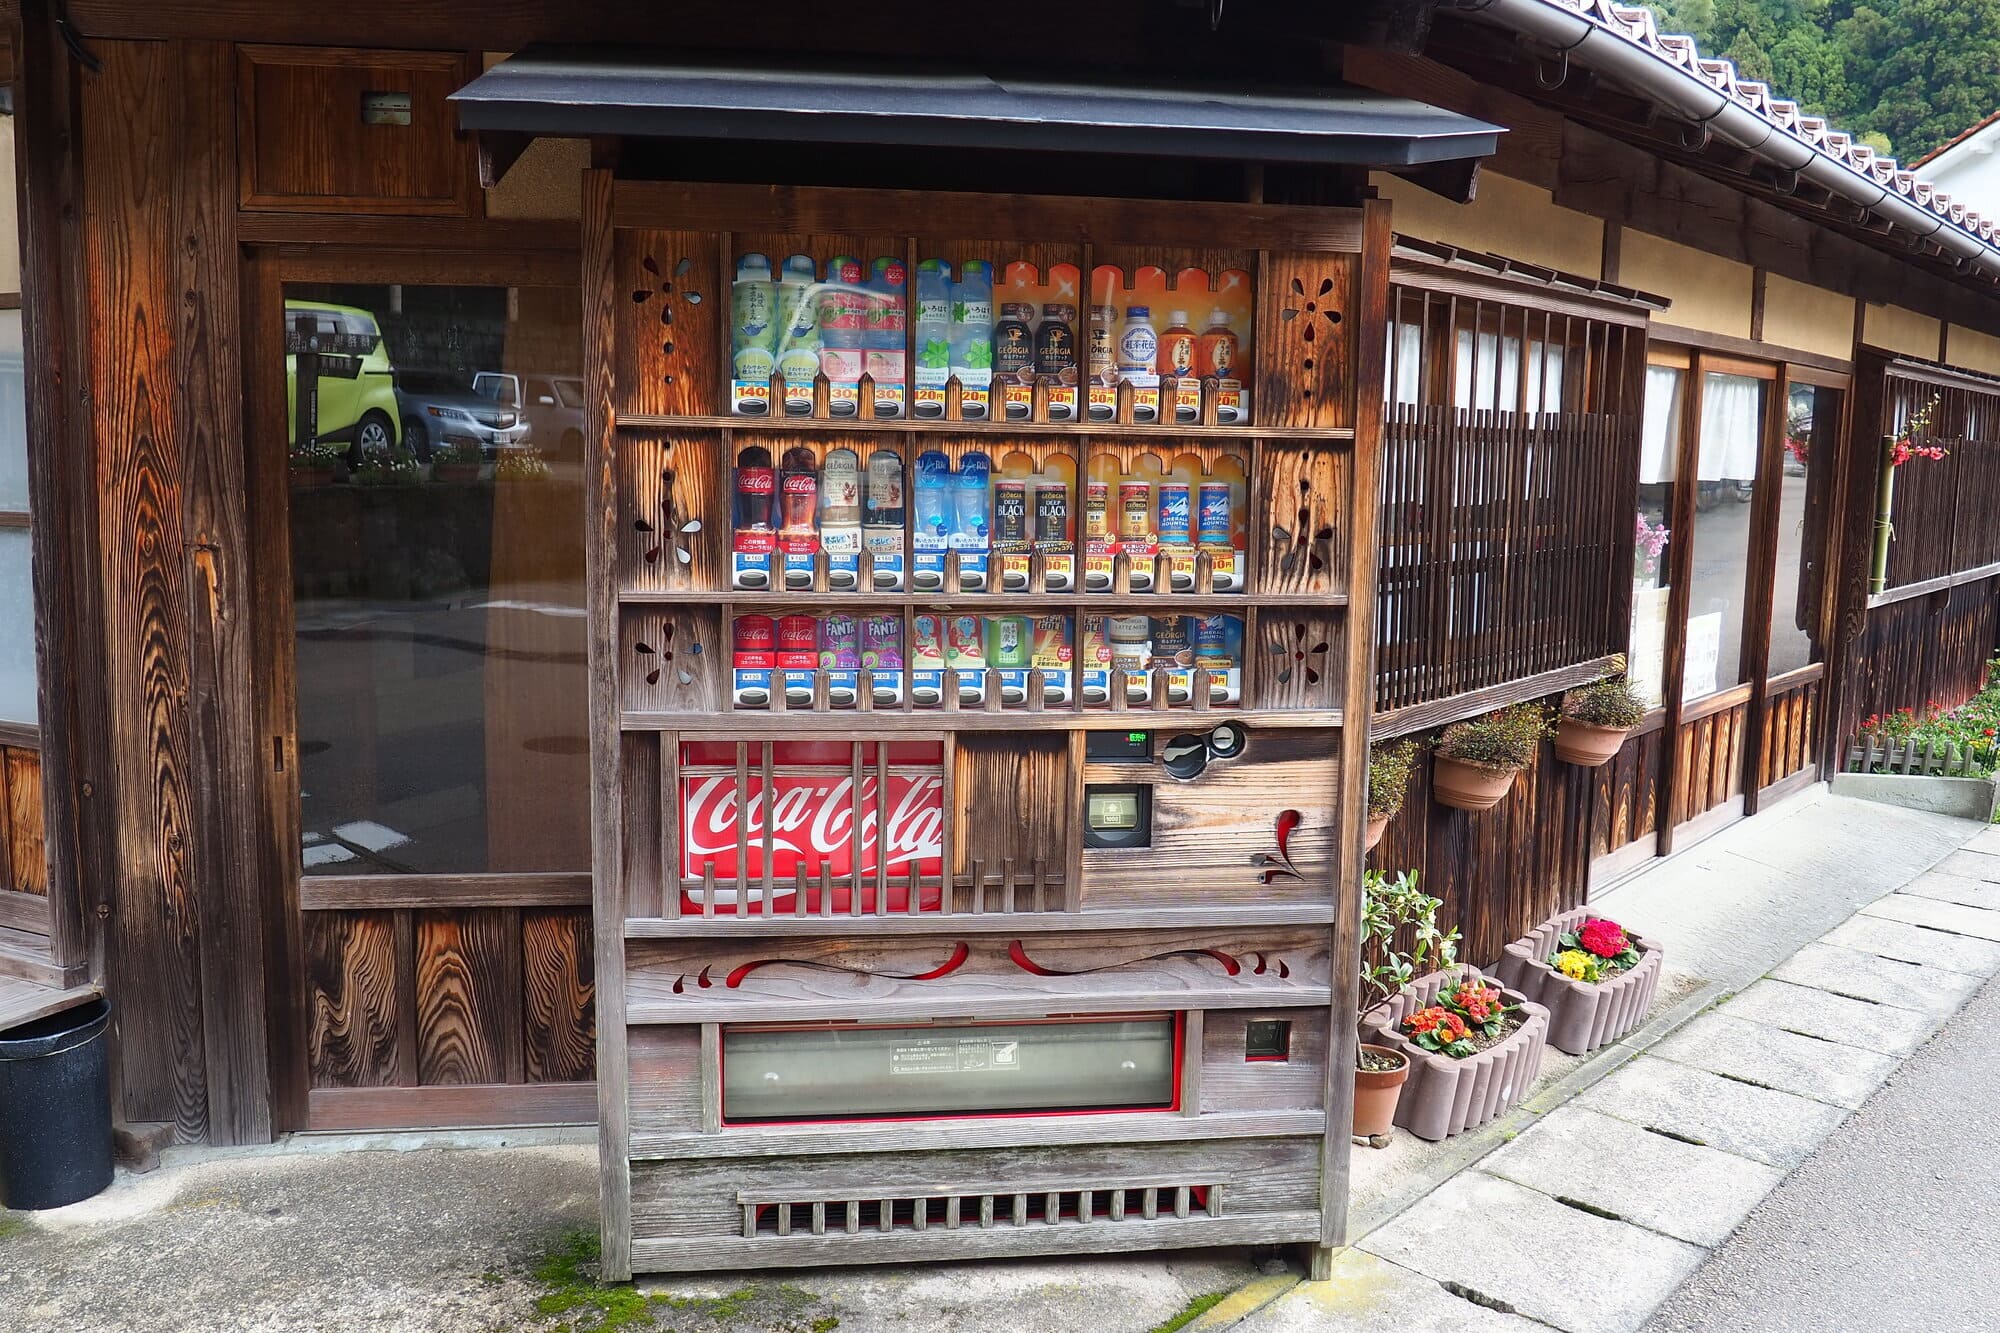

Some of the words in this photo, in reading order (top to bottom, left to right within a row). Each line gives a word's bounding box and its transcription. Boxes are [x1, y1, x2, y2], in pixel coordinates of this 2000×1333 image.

[998, 345, 1030, 354] GEORGIA
[1039, 346, 1071, 355] GEORGIA
[1125, 340, 1155, 350] 紅茶花伝
[998, 505, 1025, 516] BLACK
[1039, 506, 1066, 517] BLACK
[826, 621, 855, 636] FANTA
[868, 621, 898, 636] FANTA
[1155, 630, 1185, 639] GEORGIA
[689, 777, 942, 854] Coca-Cola
